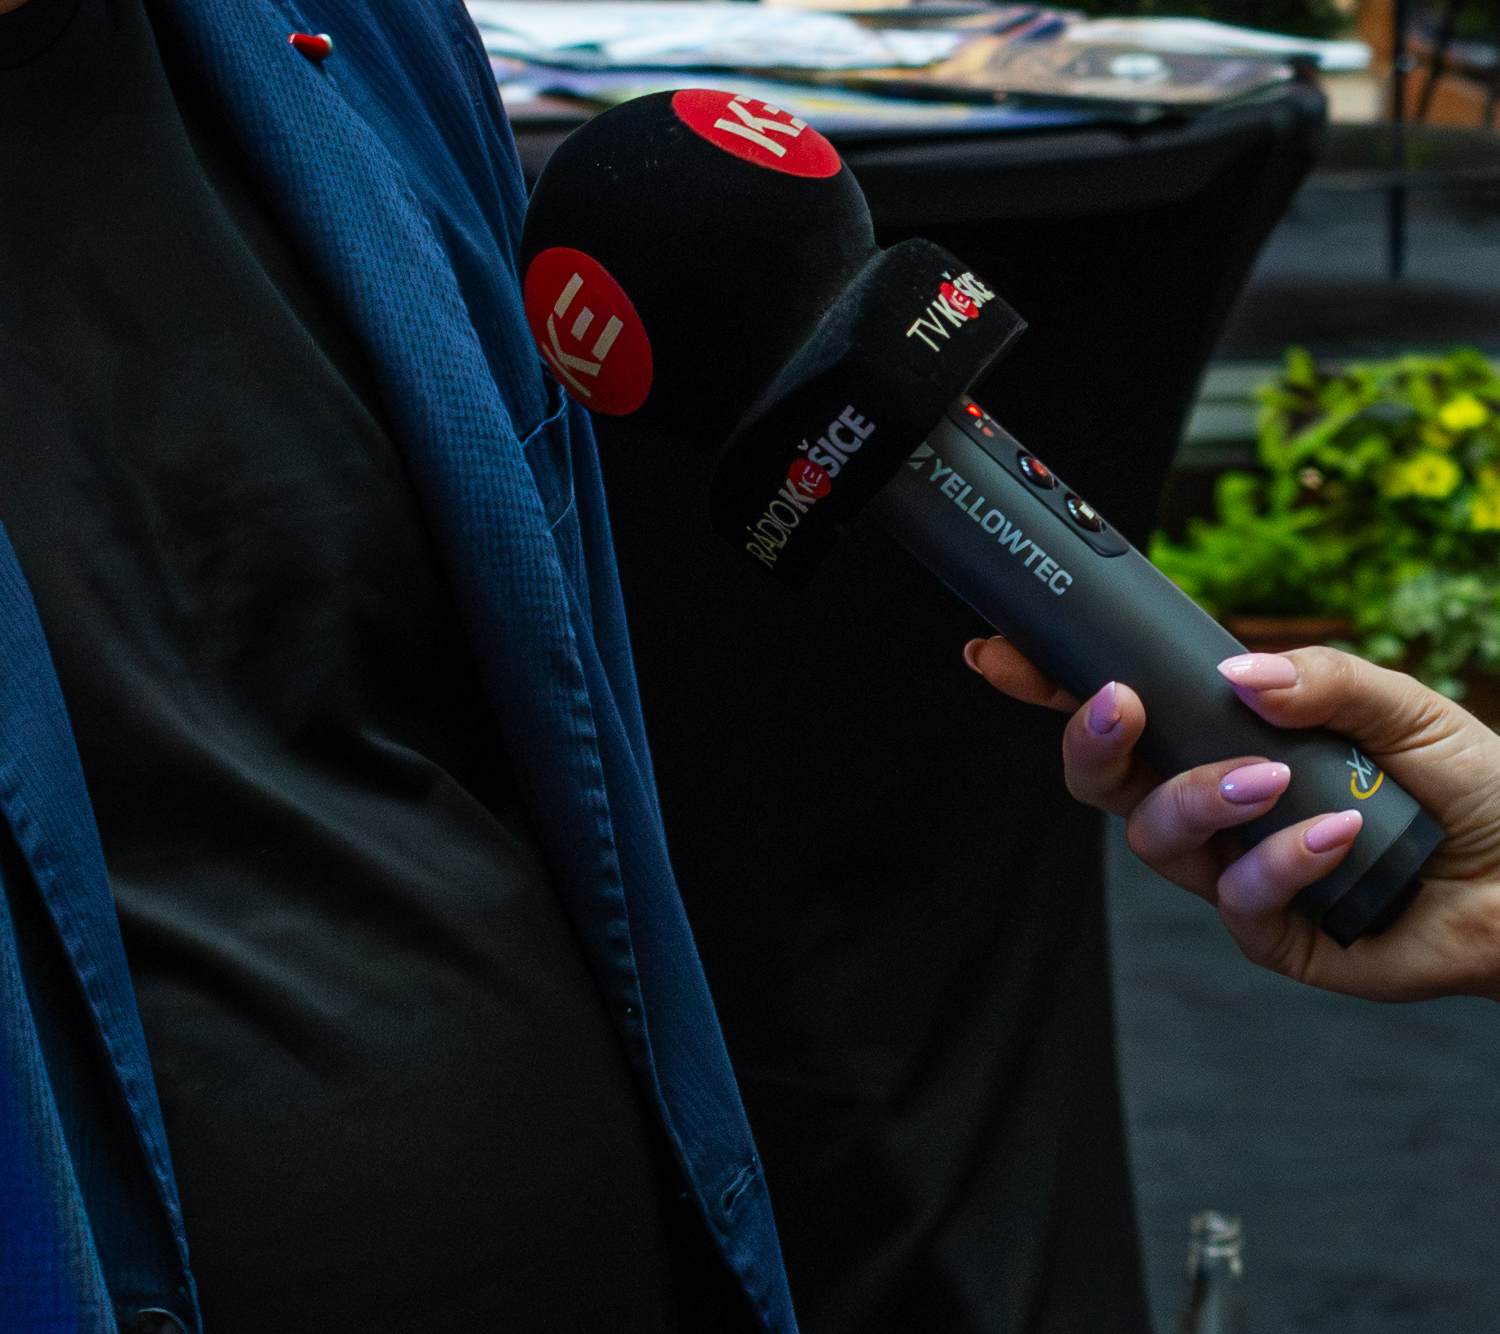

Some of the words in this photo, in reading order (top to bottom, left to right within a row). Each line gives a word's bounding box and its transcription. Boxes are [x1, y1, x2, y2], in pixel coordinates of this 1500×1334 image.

[541, 271, 624, 399] KE
[905, 306, 951, 353] TV
[929, 457, 1074, 595] YELLOWTEC
